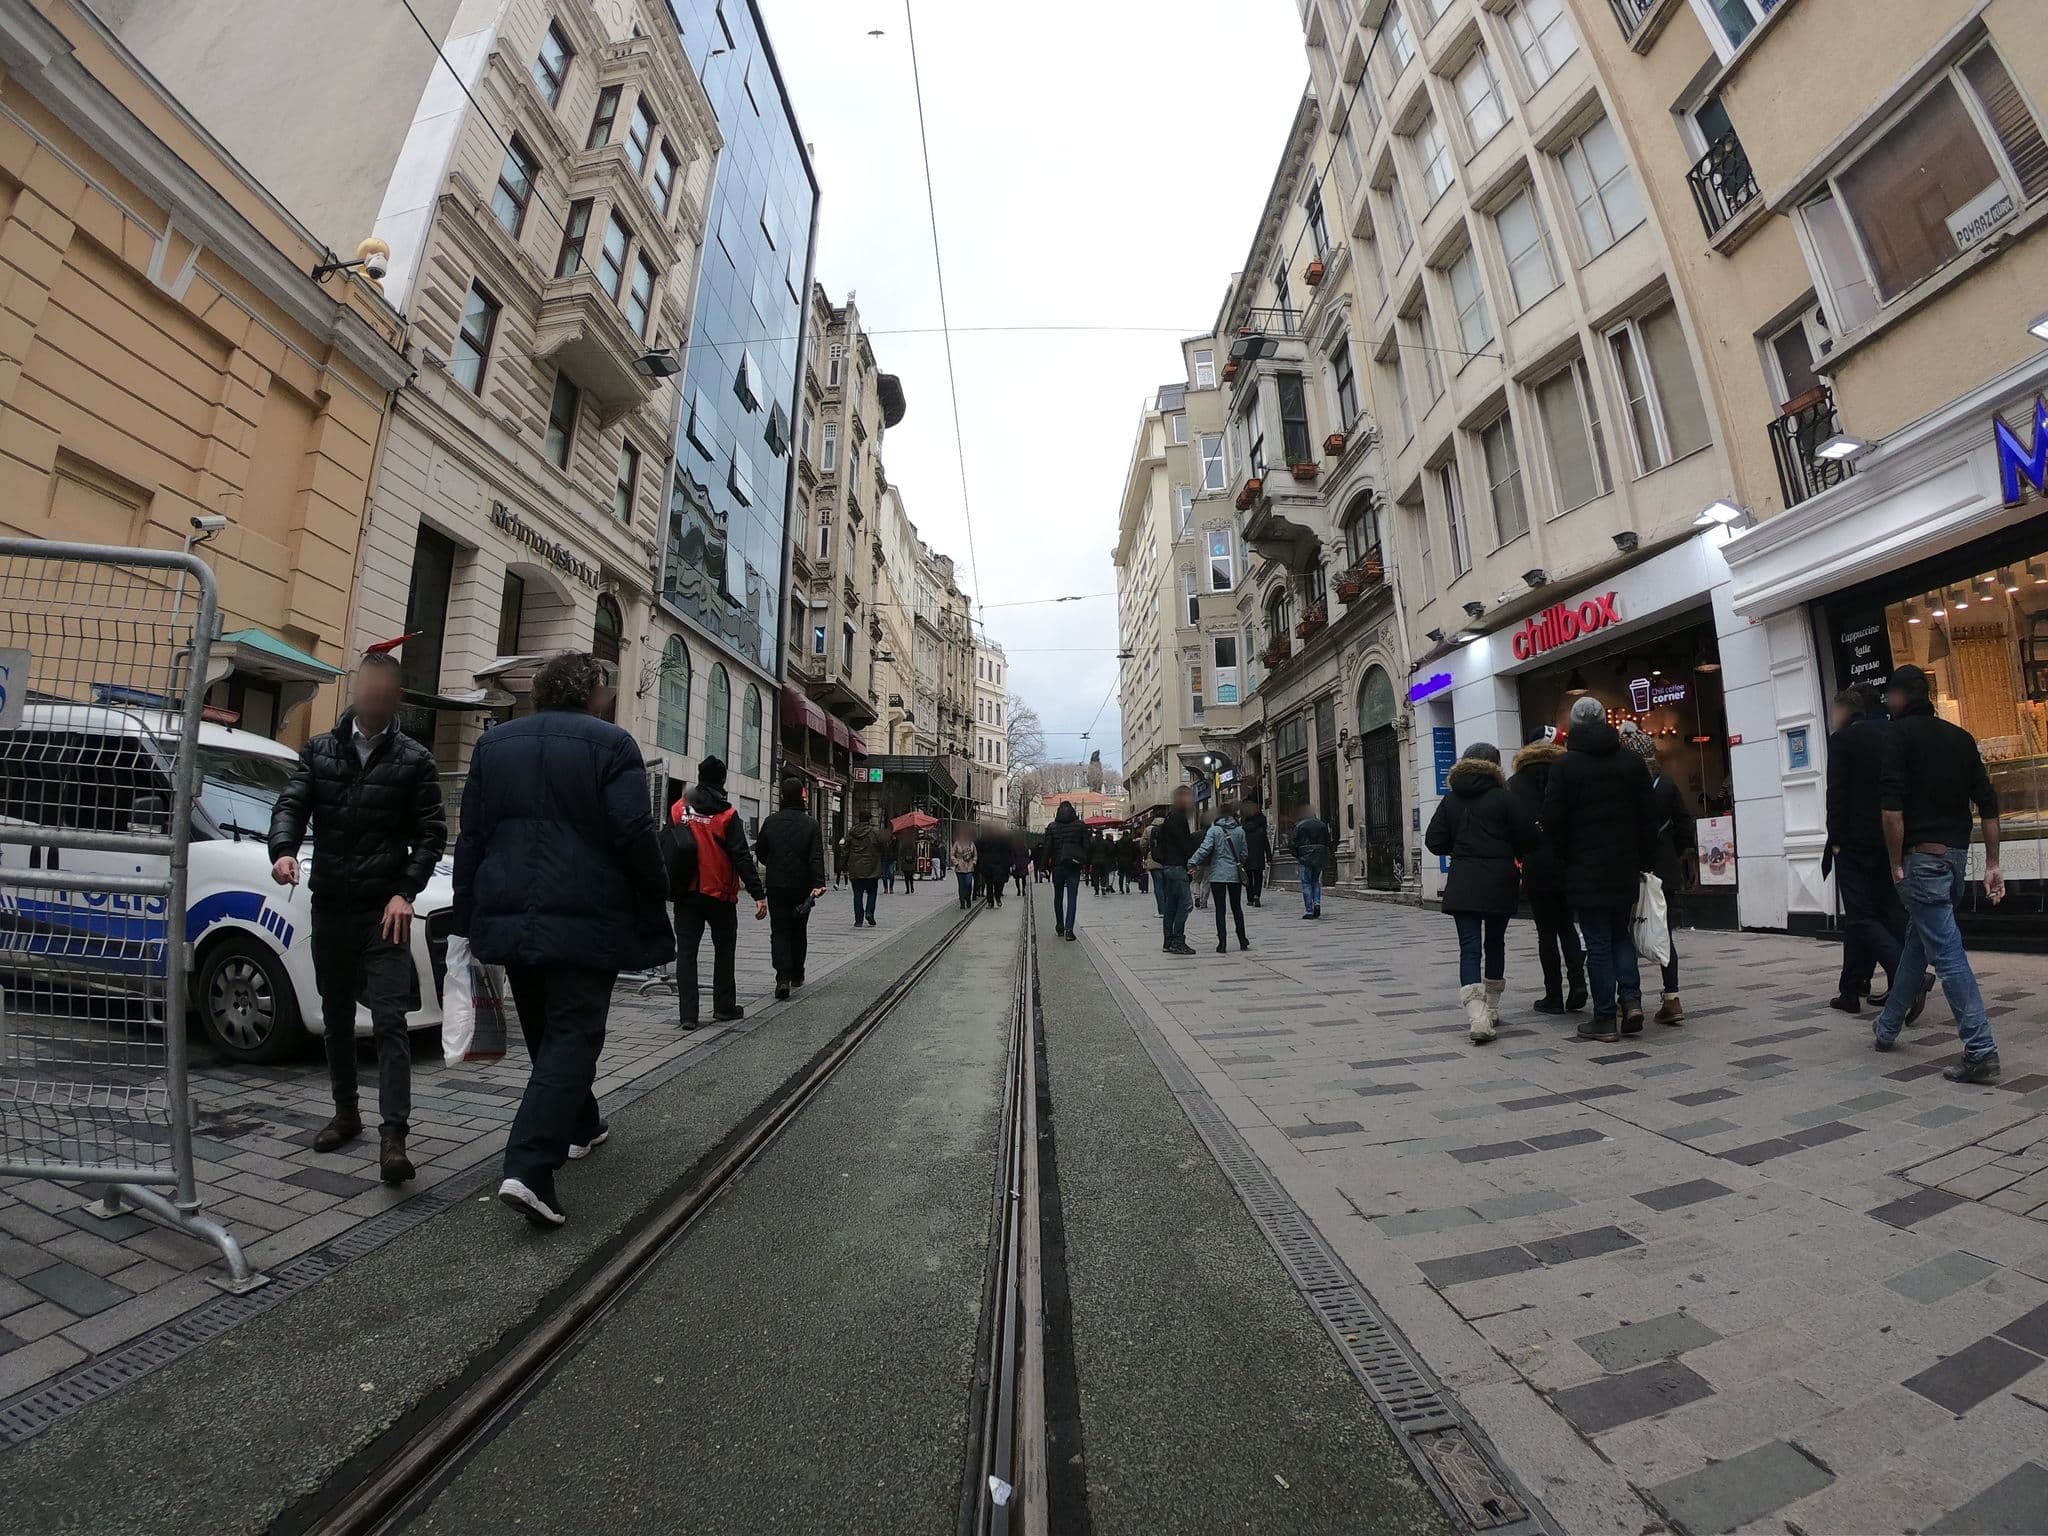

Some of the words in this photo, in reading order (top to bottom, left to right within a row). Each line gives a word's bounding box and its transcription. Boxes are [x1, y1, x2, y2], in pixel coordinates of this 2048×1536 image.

[1956, 210, 1992, 247] POYRAZ
[1512, 591, 1623, 660] chillbox
[1841, 625, 1880, 643] Cappuccino
[1855, 645, 1871, 657] Latte
[1851, 660, 1880, 676] Espresso
[1665, 684, 1685, 693] coffee
[1652, 691, 1686, 704] corner
